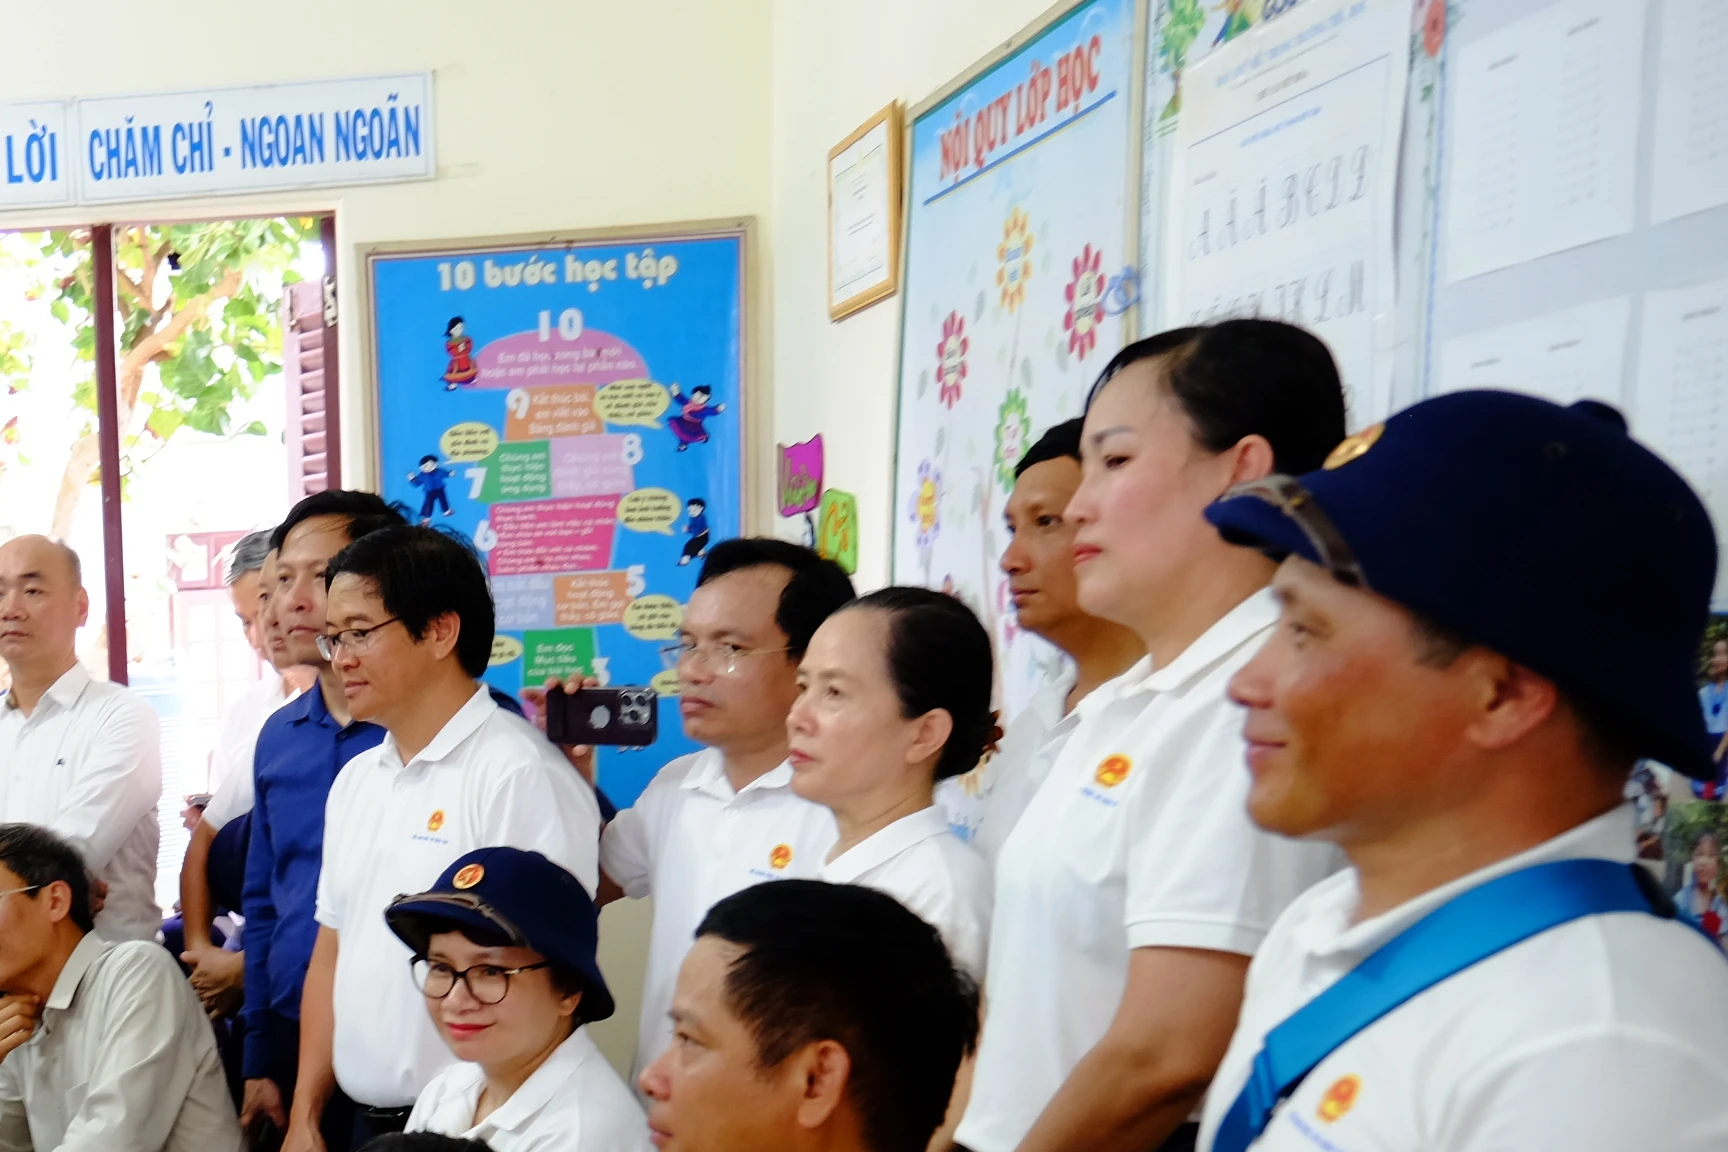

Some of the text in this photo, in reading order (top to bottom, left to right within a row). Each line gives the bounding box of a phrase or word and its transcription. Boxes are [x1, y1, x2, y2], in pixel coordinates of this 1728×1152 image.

[939, 109, 971, 183] NỘI
[974, 89, 1013, 168] QUY
[1056, 33, 1102, 113] HỌC
[6, 119, 58, 185] LỜI
[88, 115, 163, 181] CHĂM
[172, 100, 215, 175] CHỈ
[240, 112, 325, 170] NGOAN
[334, 92, 421, 162] NGOÃN
[437, 248, 678, 293] 10 bước học tập
[538, 307, 584, 342] 10
[506, 388, 531, 420] 9
[622, 432, 644, 466] 8
[464, 467, 487, 500] 7
[473, 520, 498, 551] 6
[626, 564, 646, 596] 5
[591, 657, 611, 688] 3
